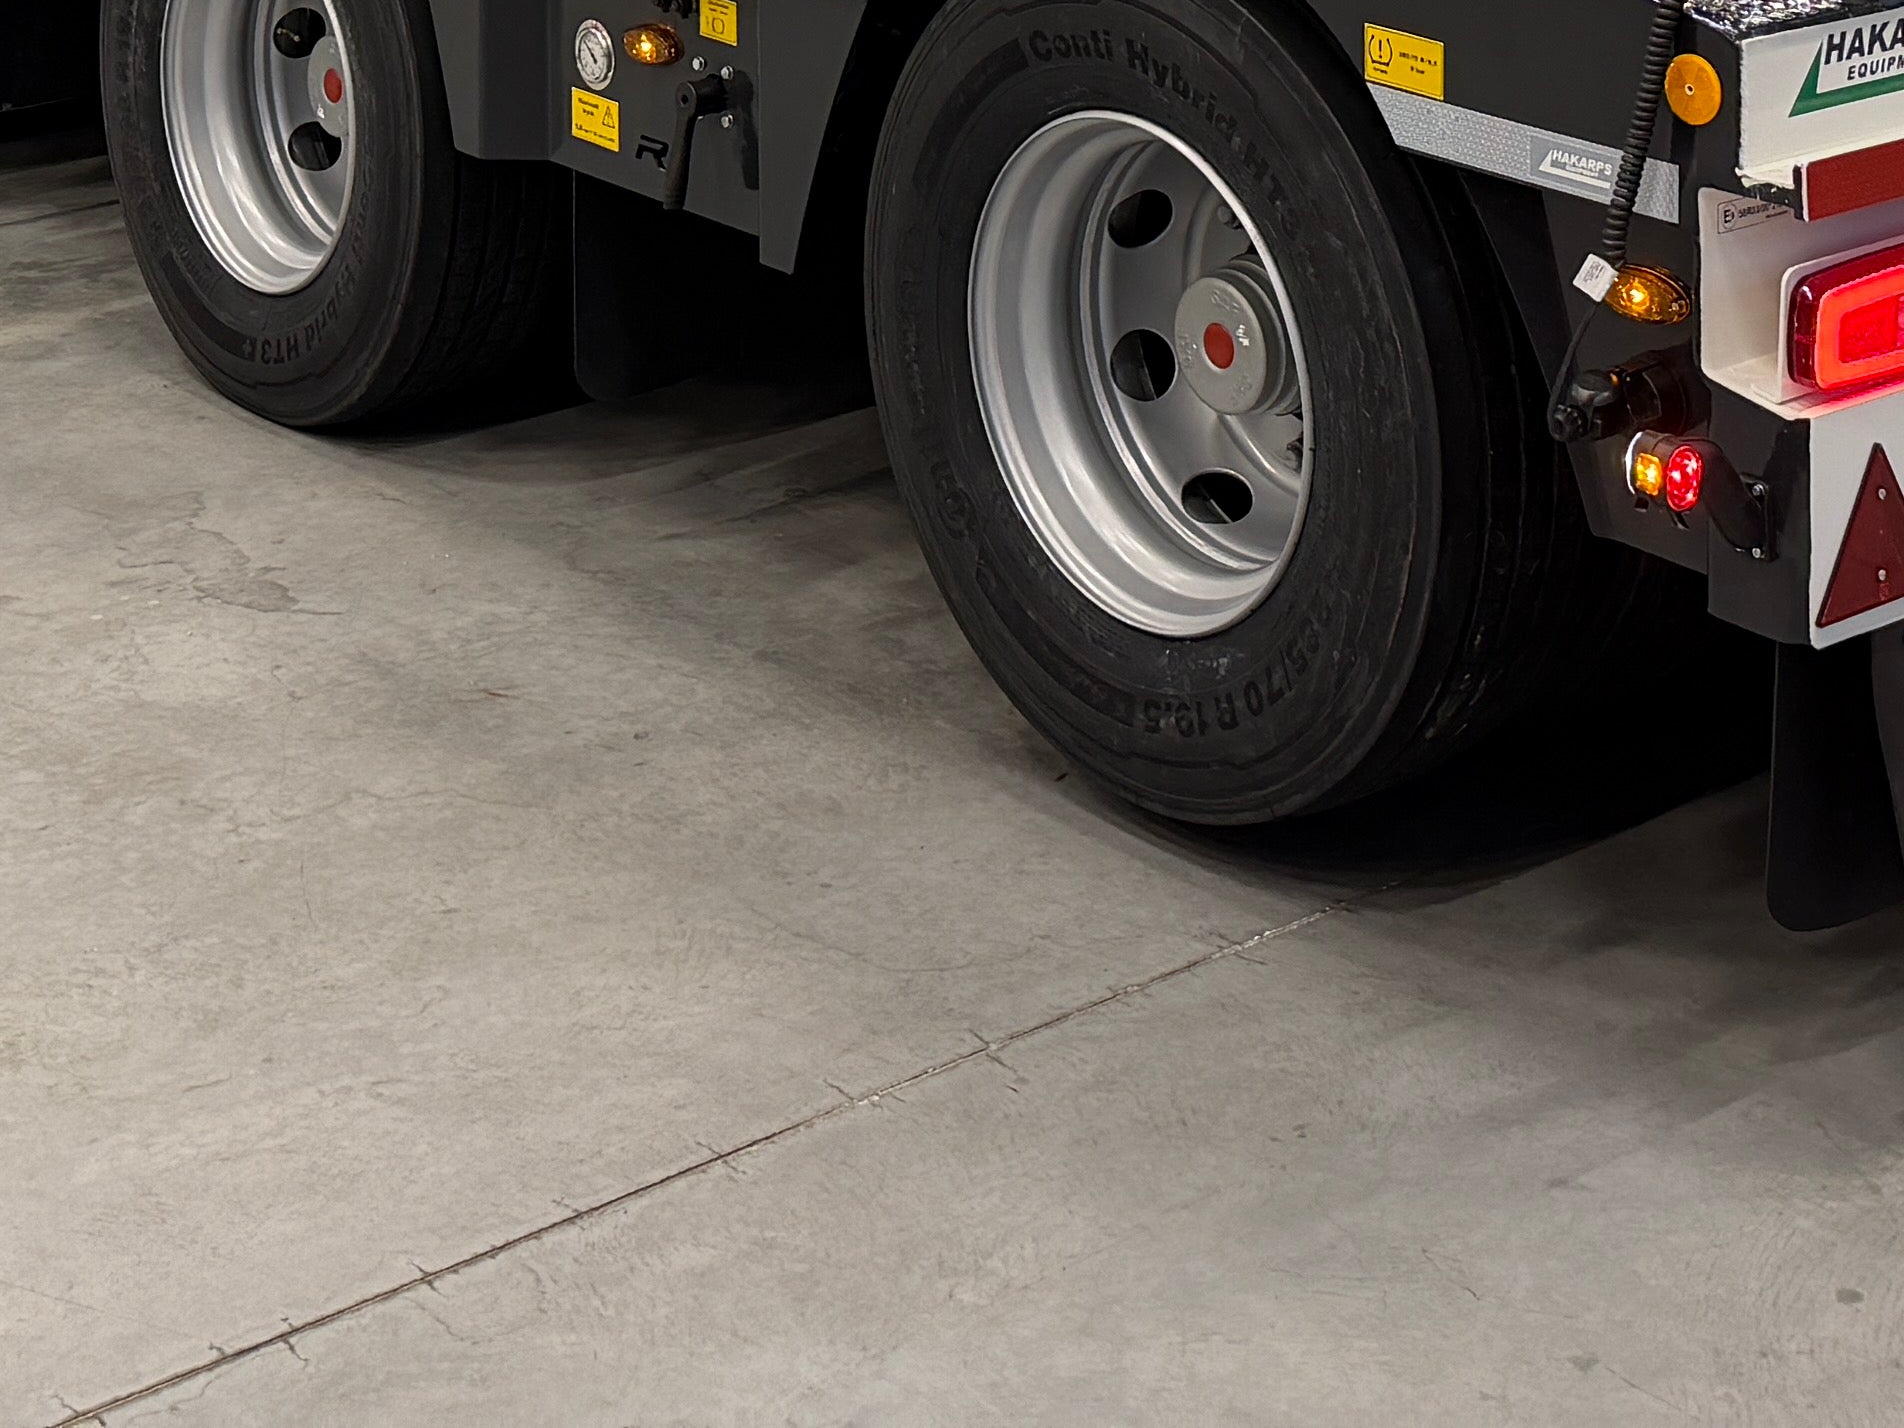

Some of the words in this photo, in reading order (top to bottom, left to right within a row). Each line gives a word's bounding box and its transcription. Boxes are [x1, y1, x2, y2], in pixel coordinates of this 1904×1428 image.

[1028, 28, 1114, 63] Conti
[1124, 37, 1239, 144] Hybrid
[1553, 148, 1613, 176] HAKARPS
